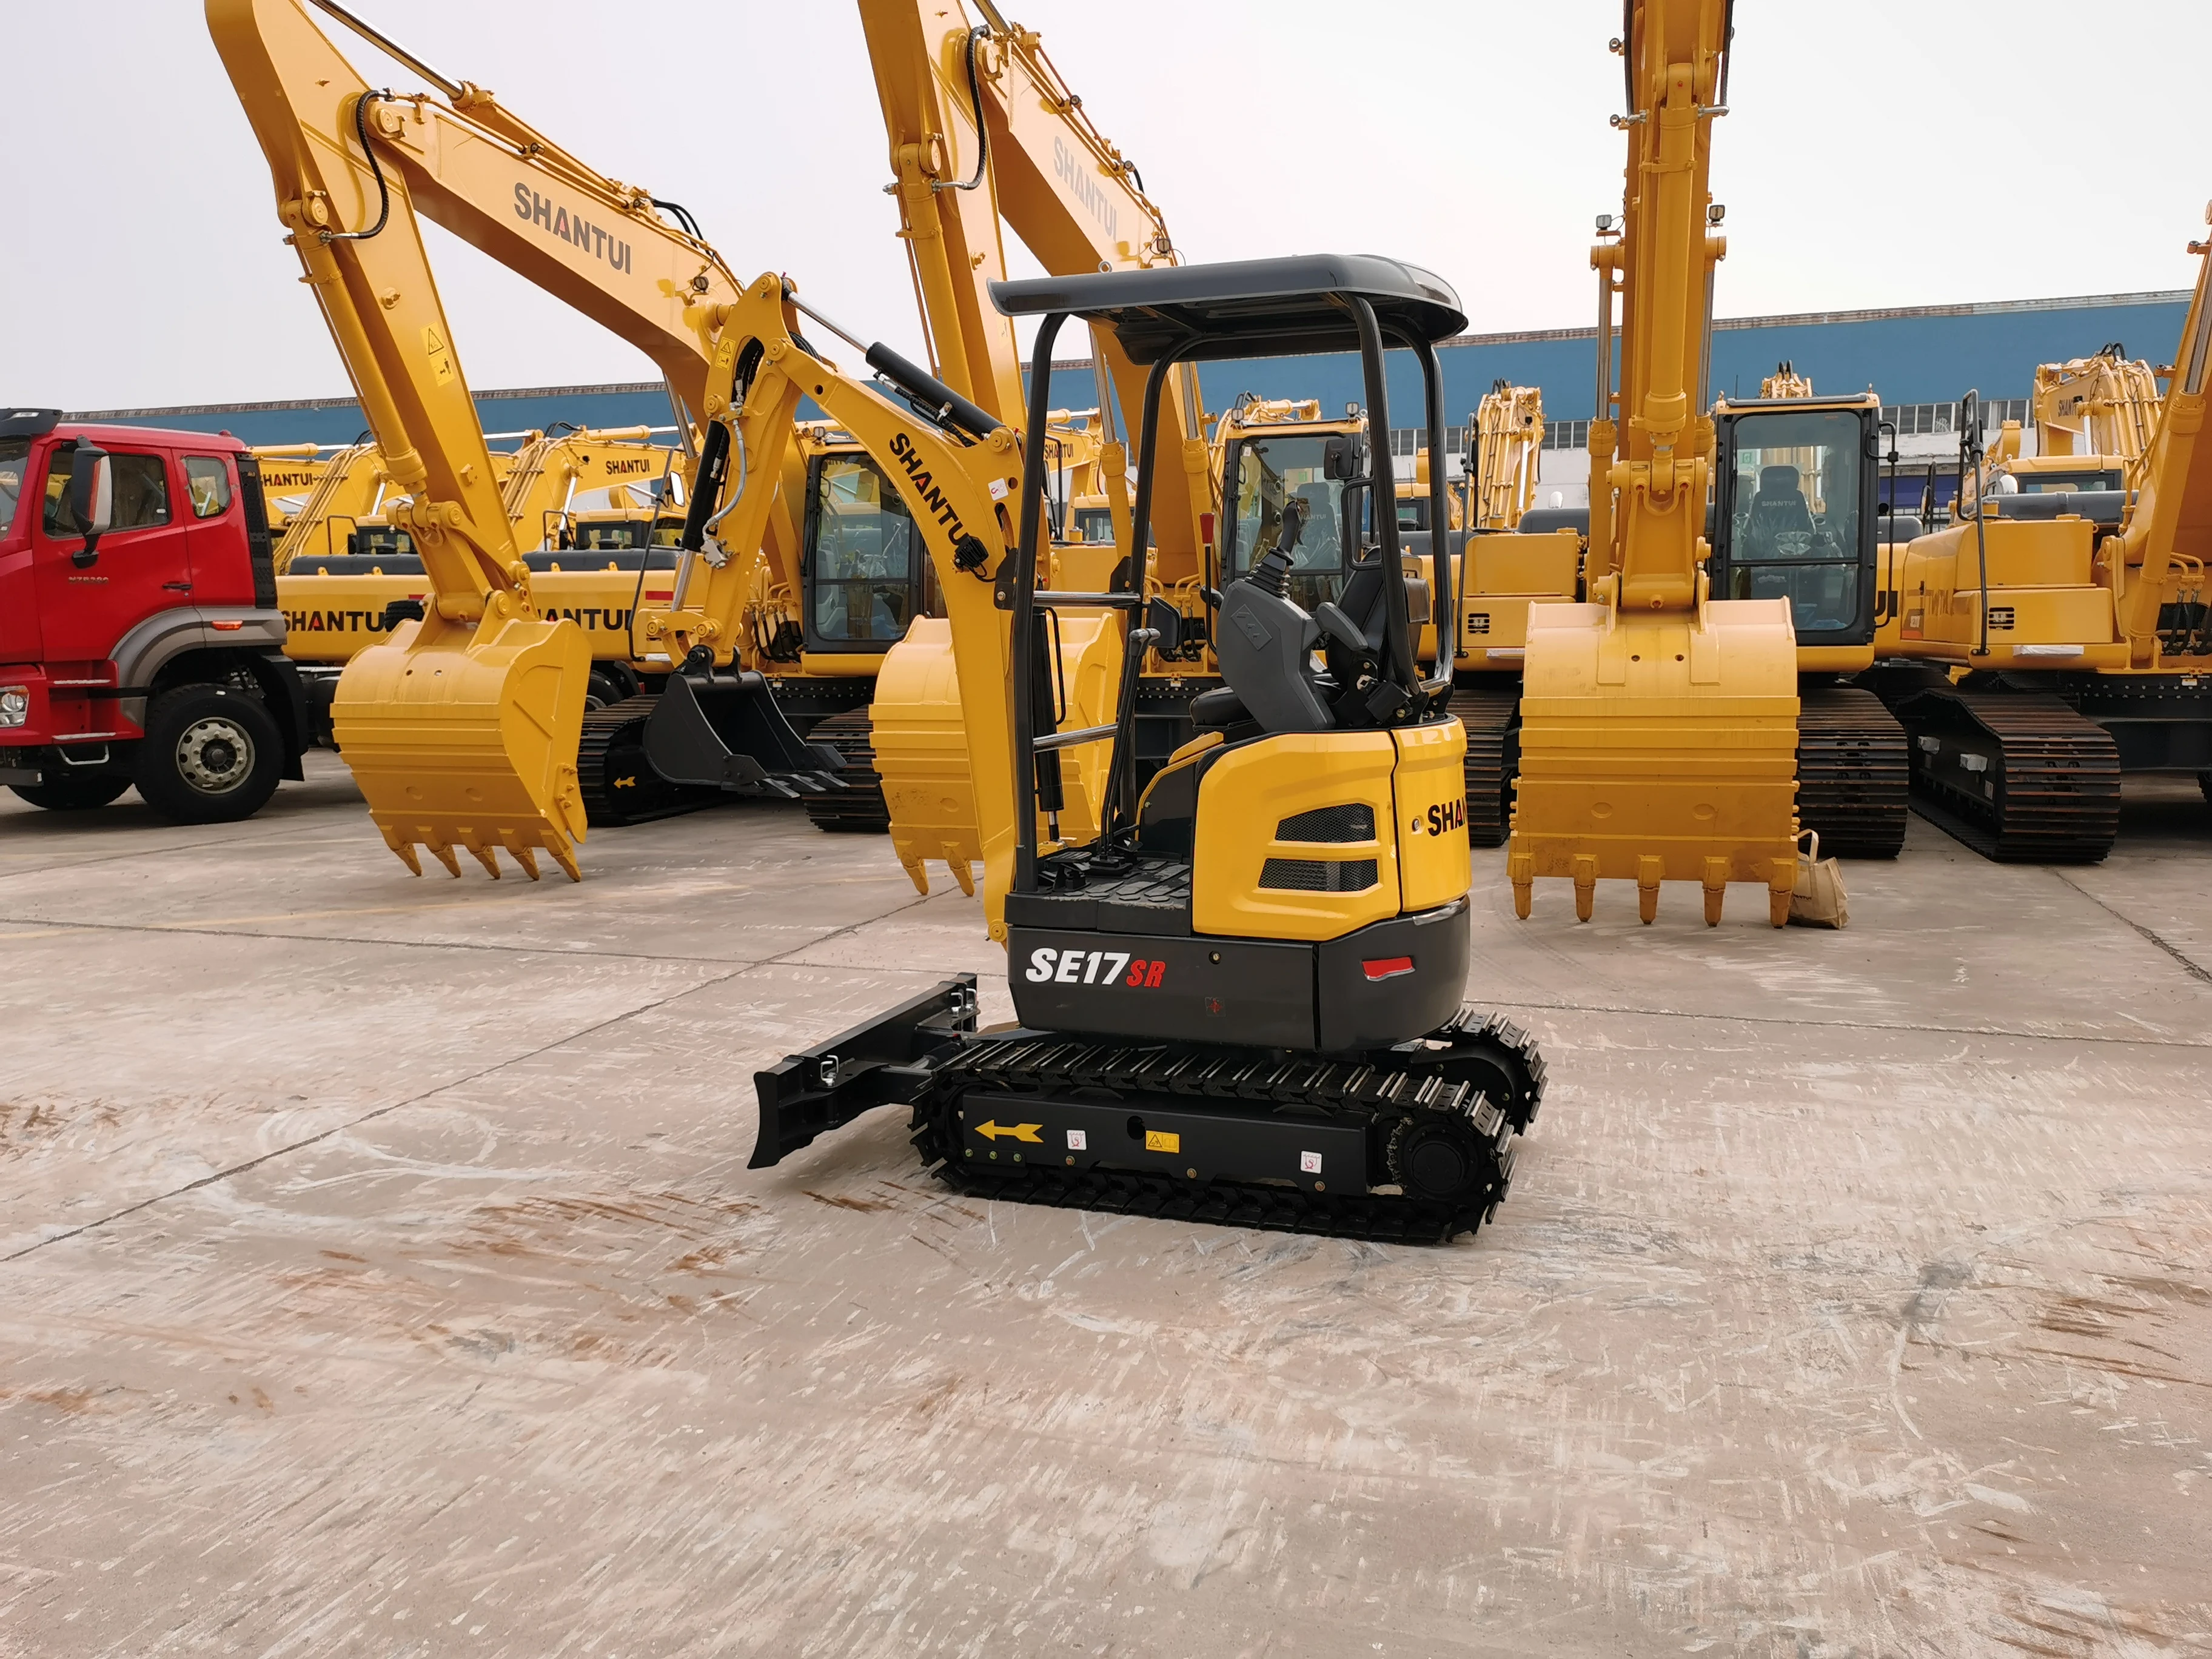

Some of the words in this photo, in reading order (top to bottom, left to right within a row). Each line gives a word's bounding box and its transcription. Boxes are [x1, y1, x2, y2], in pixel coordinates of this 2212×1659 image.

[1054, 136, 1117, 243] SHANTUI
[514, 183, 631, 275] SHANTUI
[605, 458, 650, 475] SHANTUI
[261, 473, 313, 487] HANTUI
[890, 433, 970, 546] SHANTU
[281, 610, 391, 632] SHANTU
[538, 609, 632, 631] ANTUI
